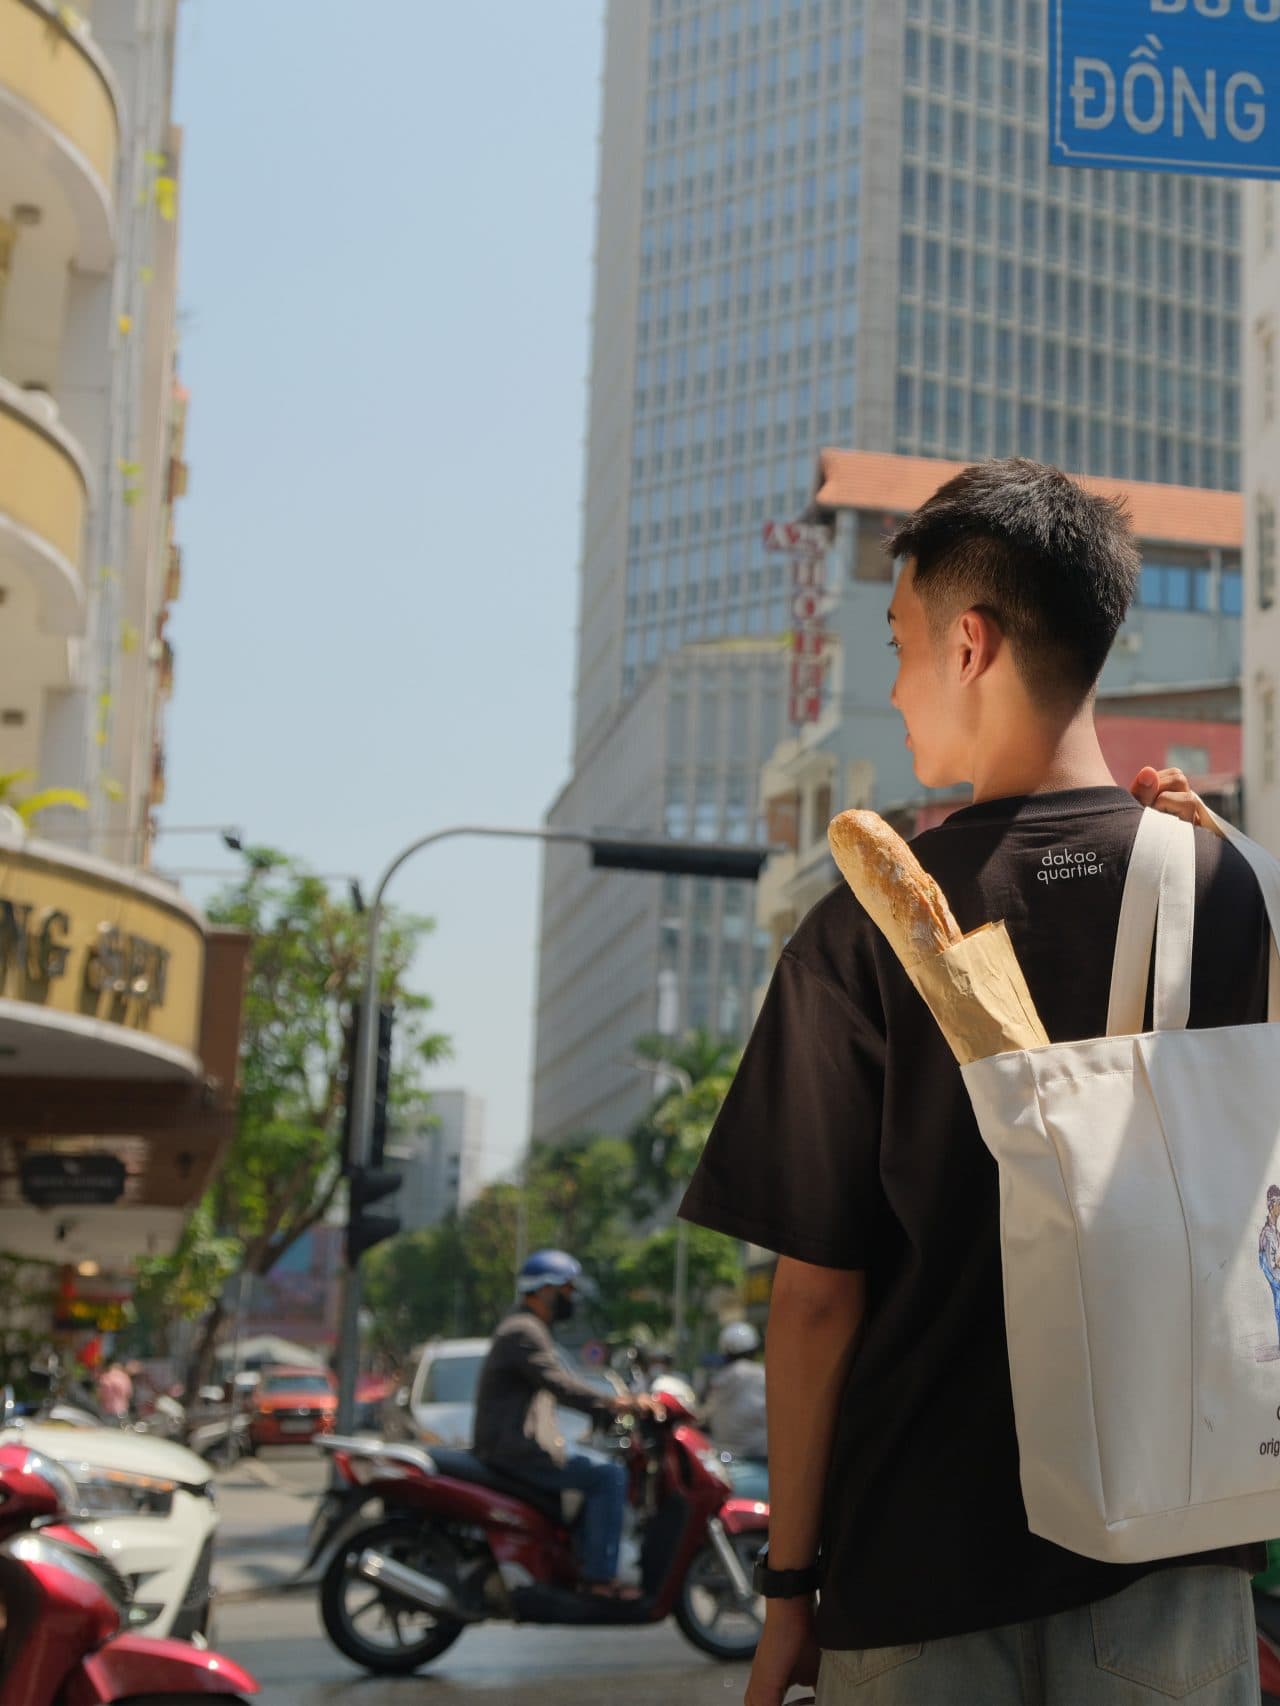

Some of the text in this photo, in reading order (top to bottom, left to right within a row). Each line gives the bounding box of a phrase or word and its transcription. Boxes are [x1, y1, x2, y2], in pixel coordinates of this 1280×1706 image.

[1069, 33, 1266, 143] ĐỒNG
[1041, 847, 1097, 866] dakao
[1036, 863, 1104, 885] quartier
